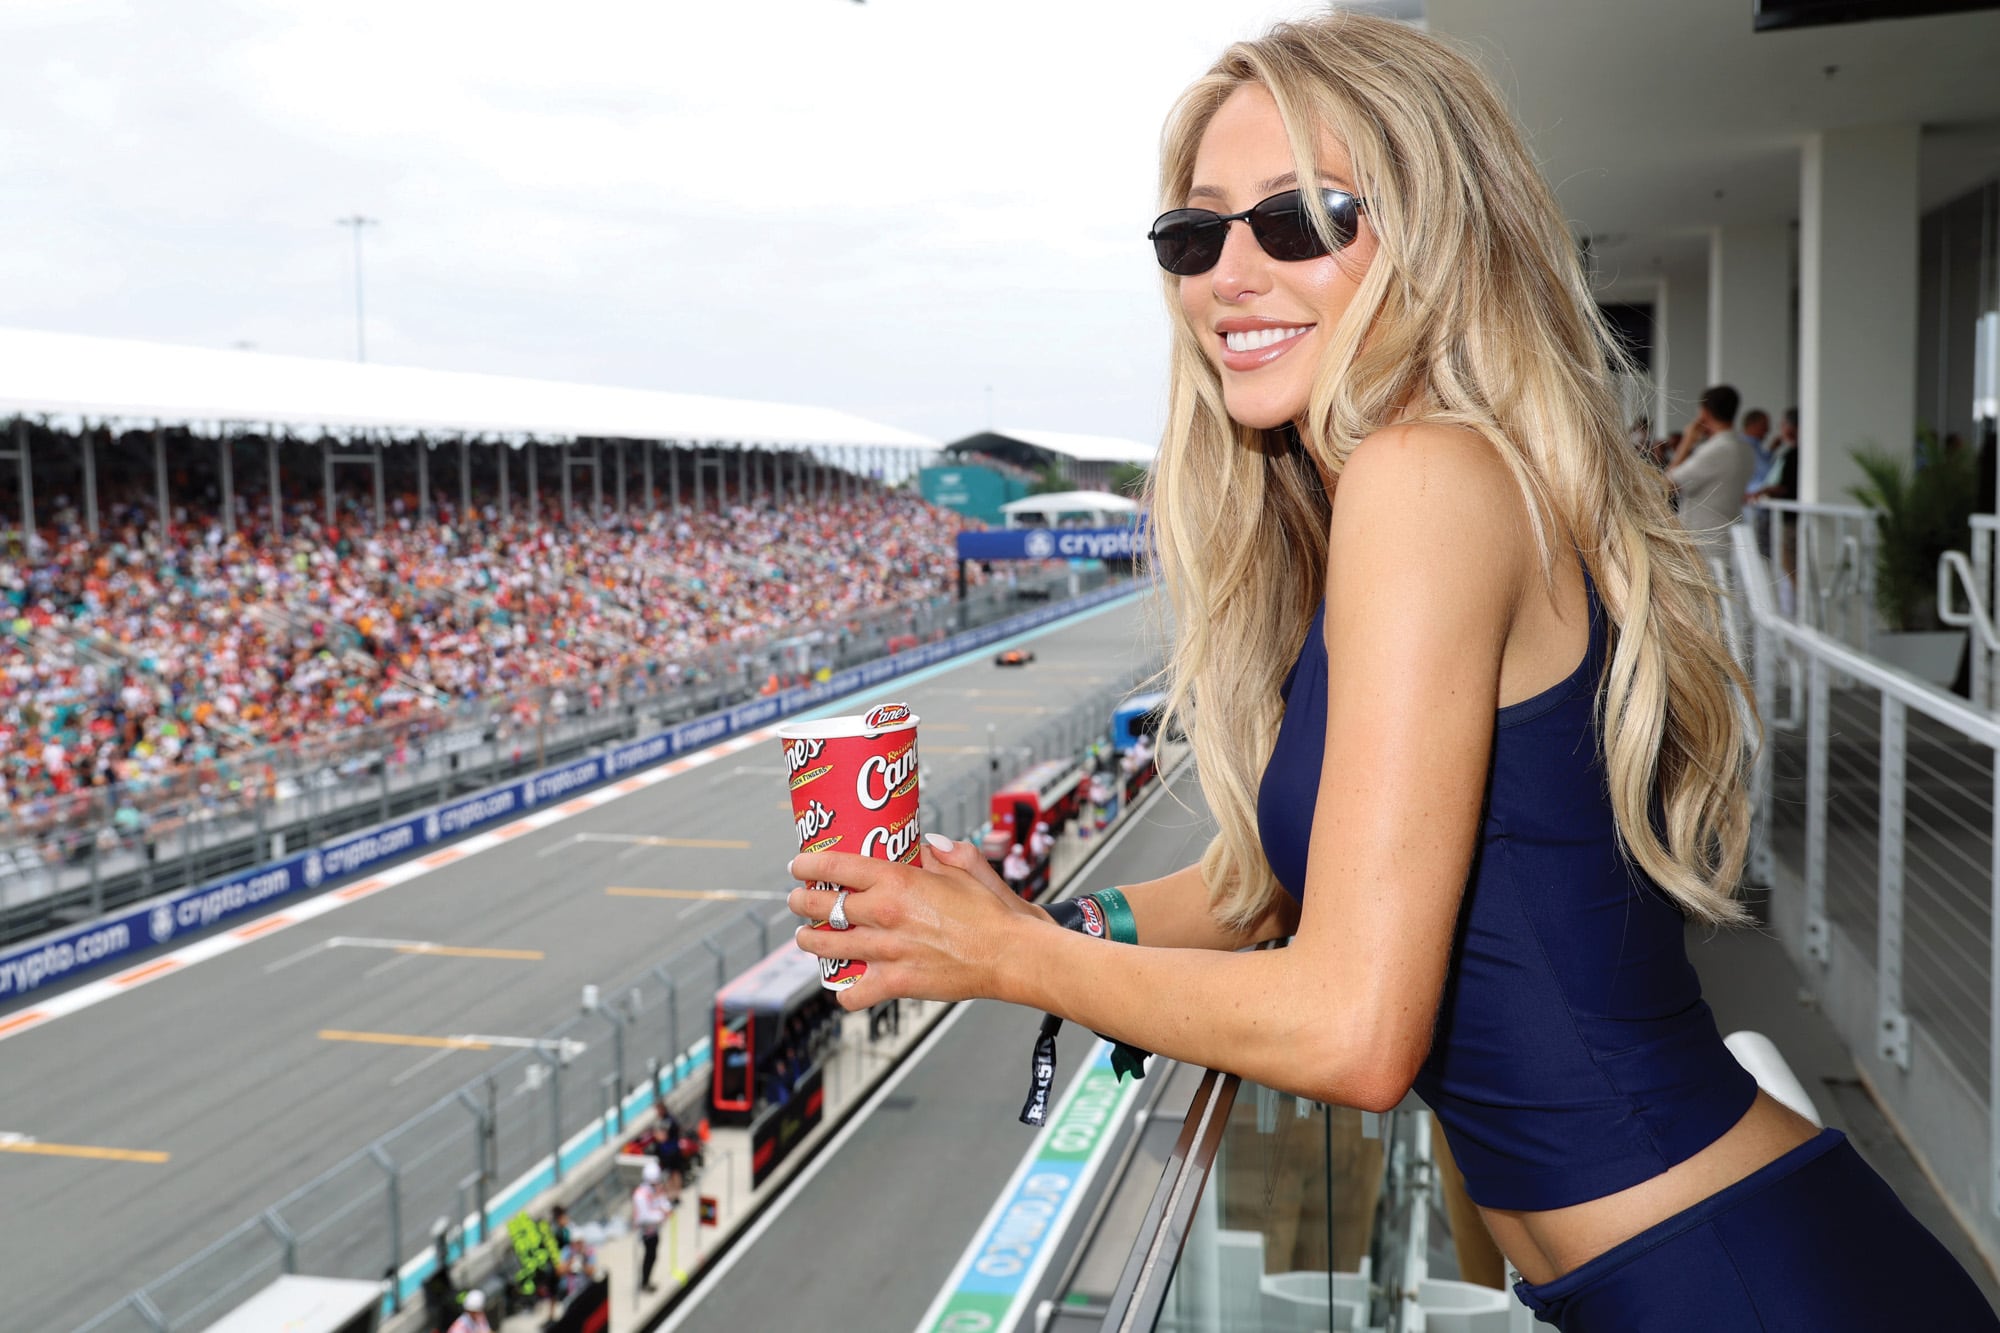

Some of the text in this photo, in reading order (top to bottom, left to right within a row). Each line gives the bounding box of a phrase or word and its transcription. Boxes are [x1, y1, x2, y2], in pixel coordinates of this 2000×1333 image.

[441, 791, 514, 832] crypto.com
[324, 825, 413, 873] crypto.com
[177, 868, 290, 926] crypto.com
[0, 923, 130, 992] rypto.com
